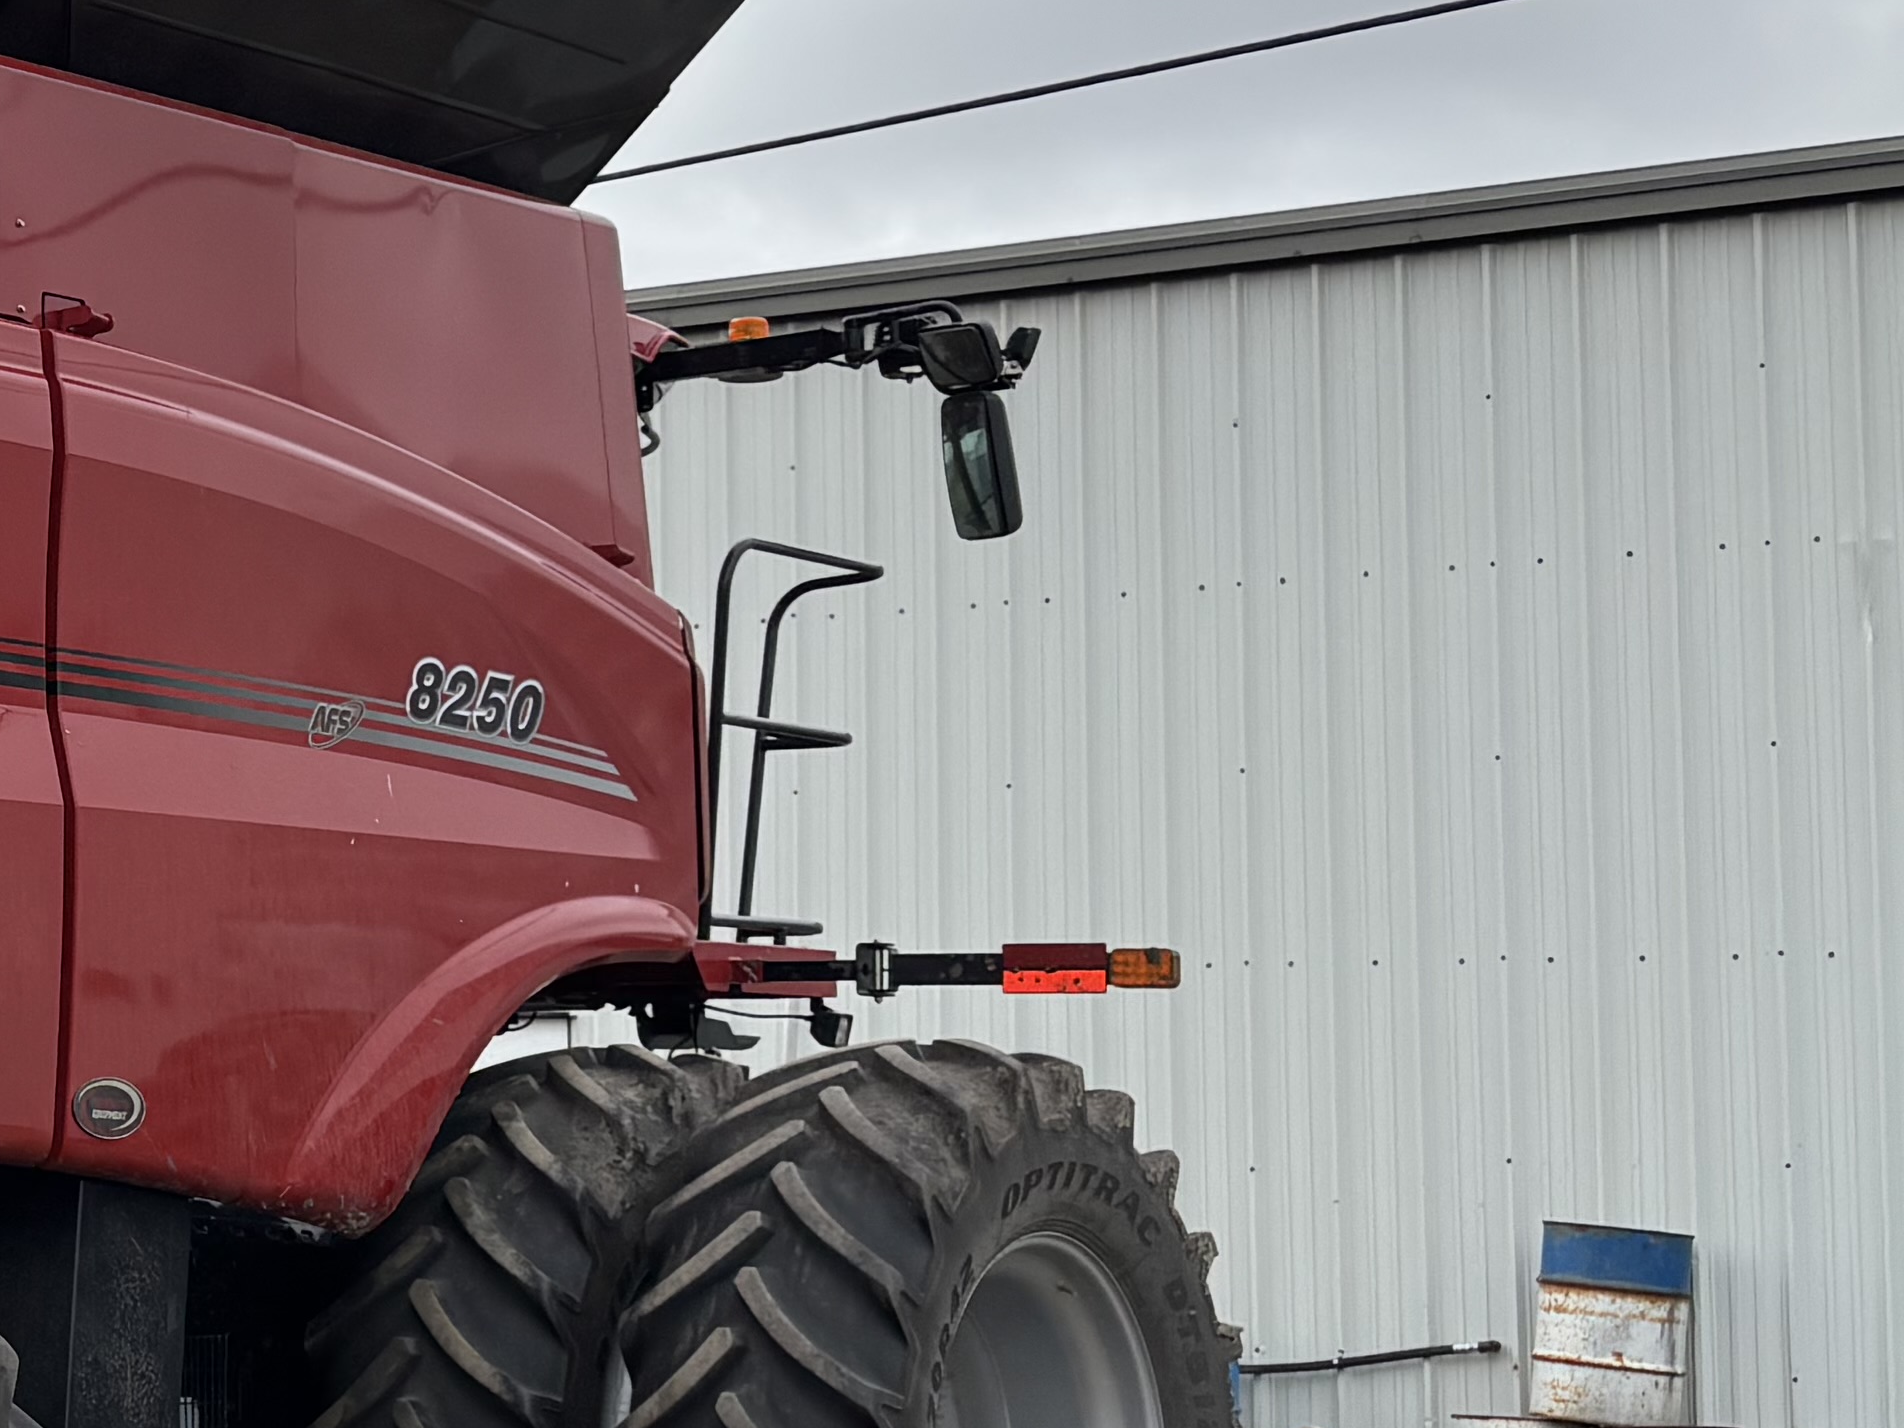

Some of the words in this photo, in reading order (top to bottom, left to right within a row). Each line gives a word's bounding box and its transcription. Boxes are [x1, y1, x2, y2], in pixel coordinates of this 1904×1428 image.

[309, 703, 355, 737] AFS
[405, 657, 544, 744] 8250
[1001, 1160, 1161, 1248] OPTITRAC
